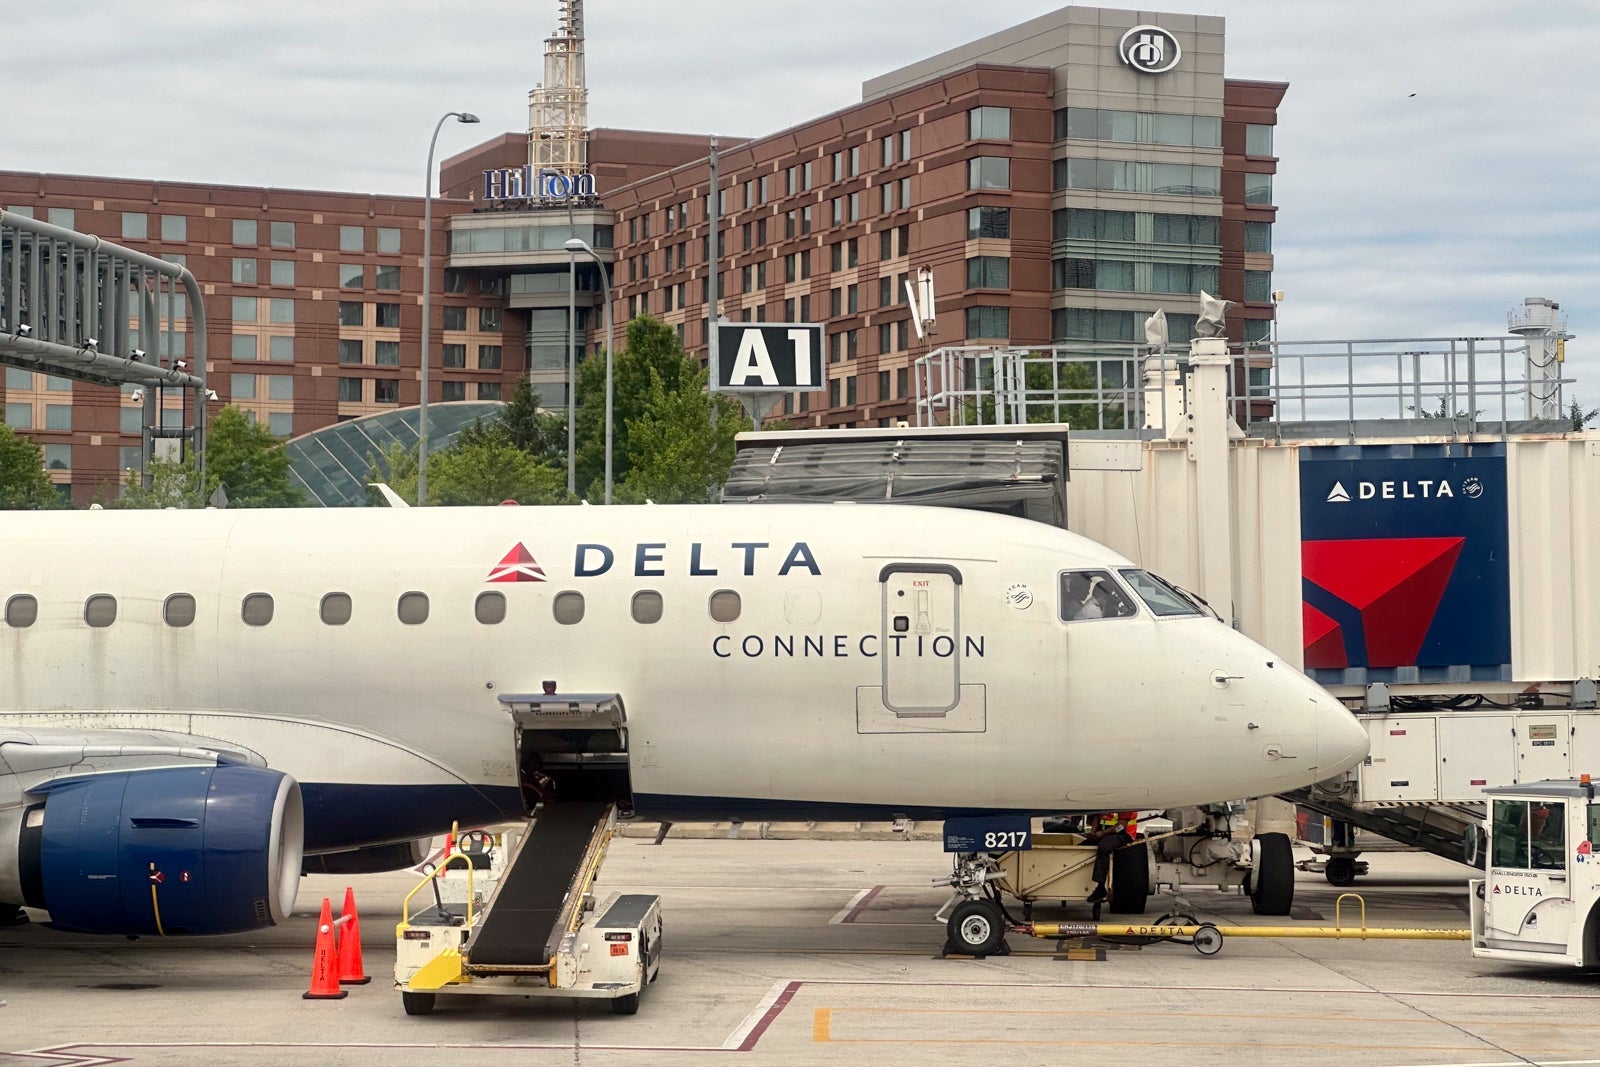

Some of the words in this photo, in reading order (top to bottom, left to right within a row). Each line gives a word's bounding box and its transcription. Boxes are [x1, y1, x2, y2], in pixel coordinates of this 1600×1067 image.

[482, 164, 598, 200] Hilton
[729, 328, 812, 386] A1
[1359, 480, 1454, 500] DELTA
[574, 542, 822, 577] DELTA
[712, 635, 985, 658] CONNECTION
[984, 832, 1027, 848] 8217
[1504, 885, 1543, 897] DELTA
[1139, 926, 1184, 936] DELTA
